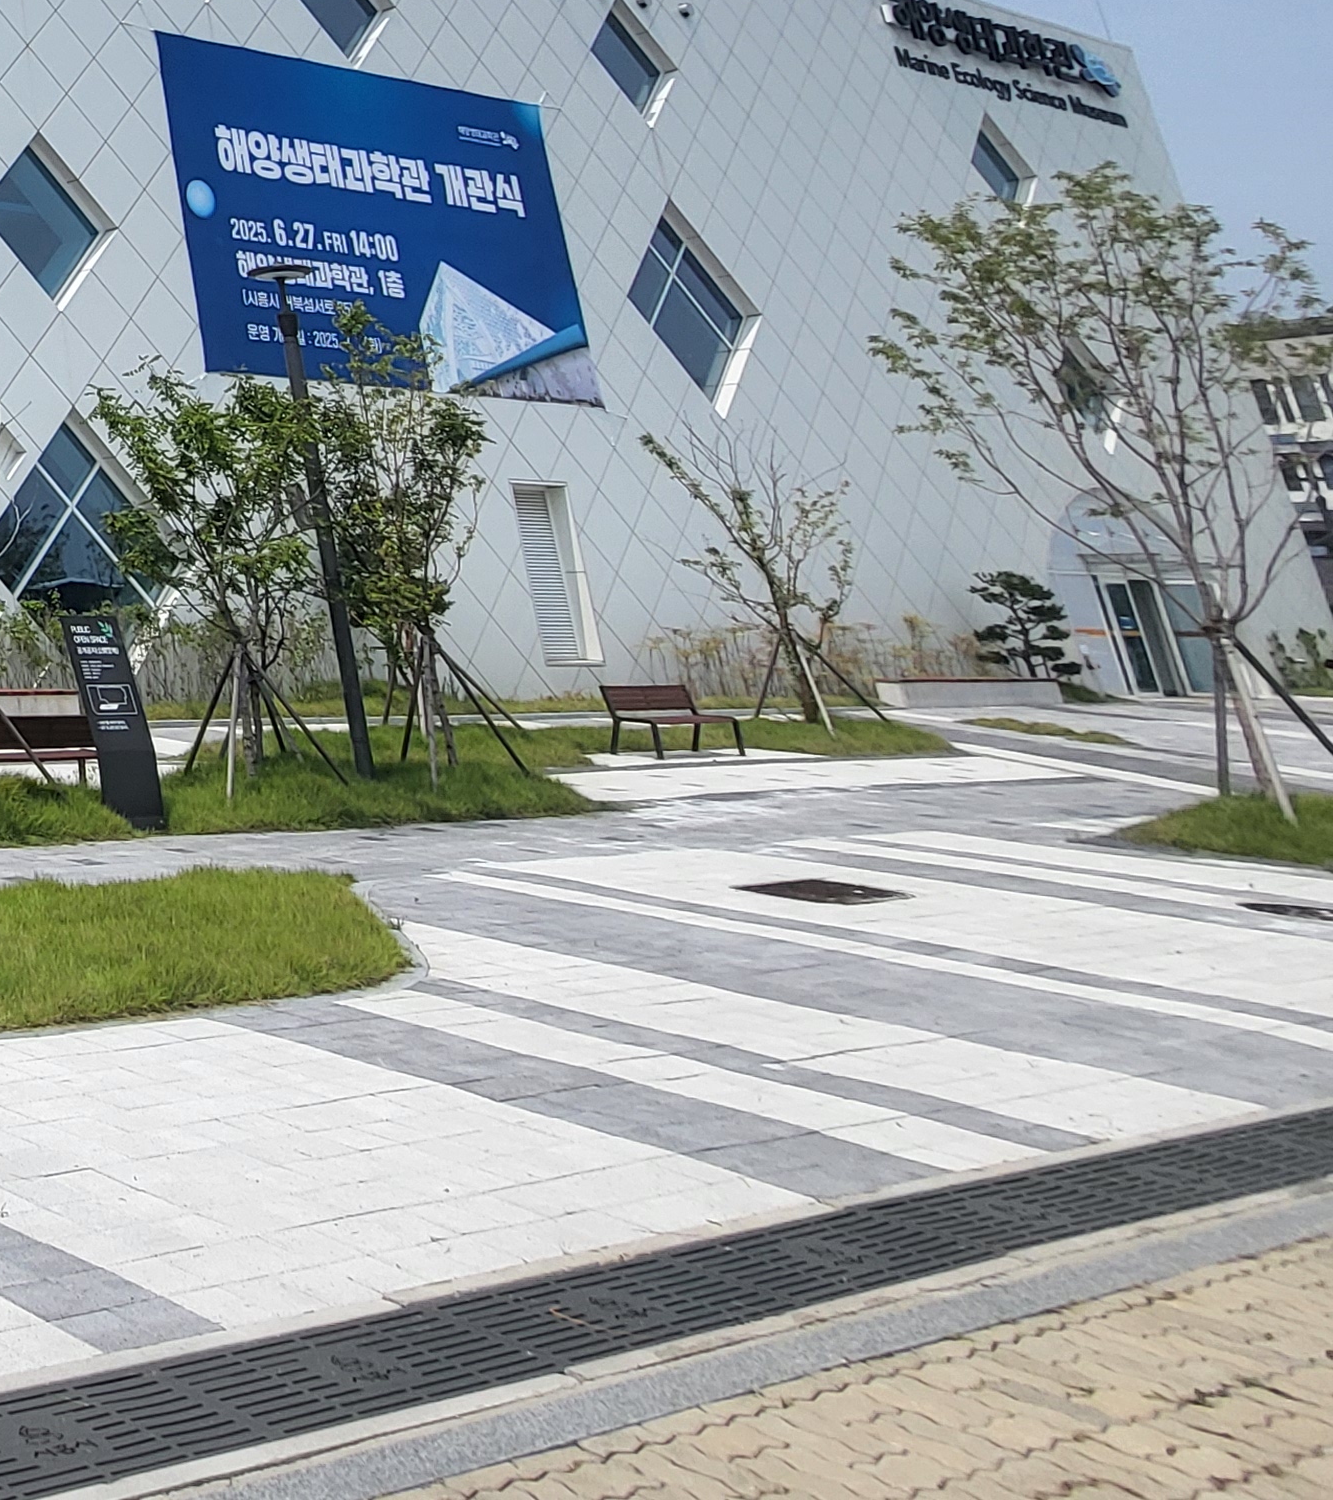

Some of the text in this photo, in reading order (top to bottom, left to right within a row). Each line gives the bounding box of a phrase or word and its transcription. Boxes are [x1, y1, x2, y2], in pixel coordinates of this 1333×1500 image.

[894, 46, 950, 79] Marine
[950, 62, 1011, 101] Ecology
[214, 124, 527, 218] 해양생태과학관 개관식
[230, 218, 272, 243] 2025.
[322, 231, 349, 254] FRI
[349, 230, 400, 262] 14:00
[242, 288, 280, 309] (시흥시
[377, 269, 406, 299] 1층
[247, 323, 270, 341] 운영
[272, 326, 307, 346] 개일
